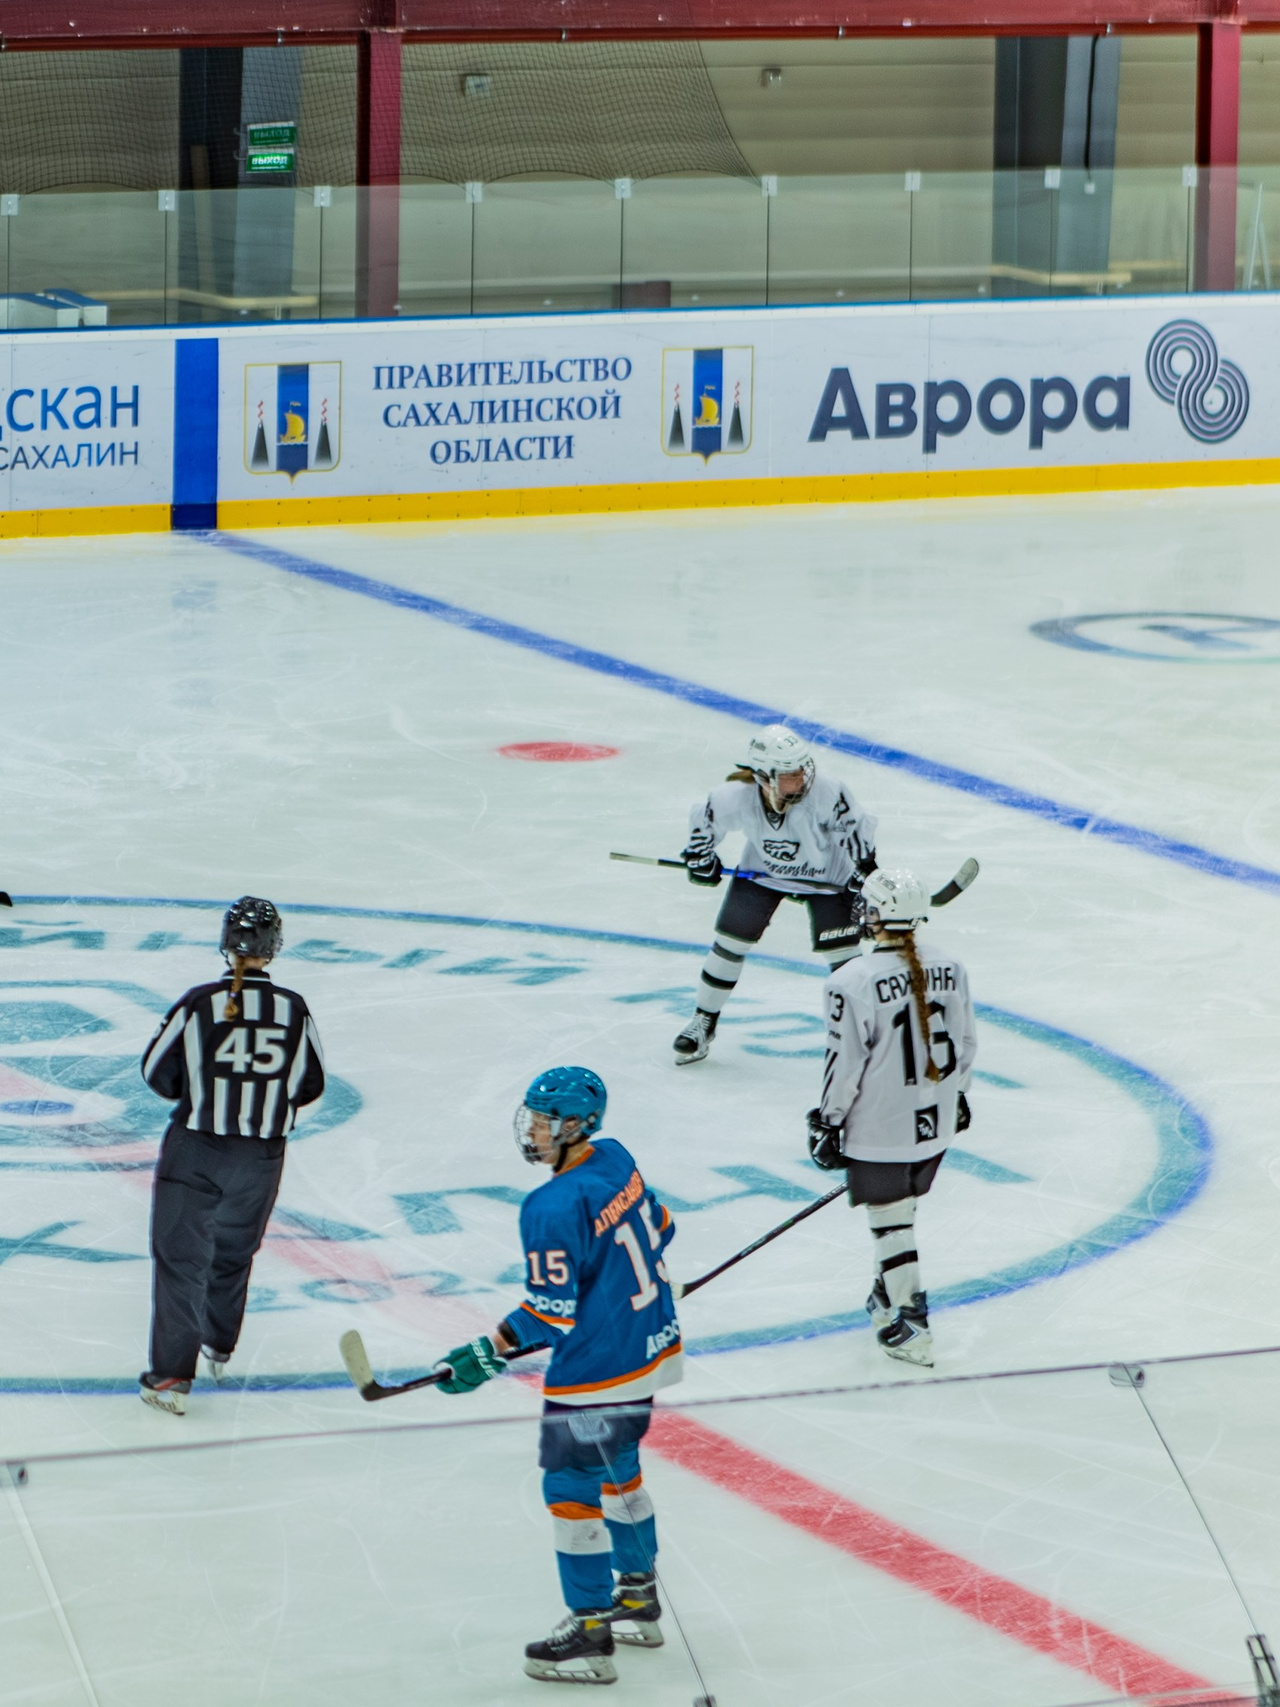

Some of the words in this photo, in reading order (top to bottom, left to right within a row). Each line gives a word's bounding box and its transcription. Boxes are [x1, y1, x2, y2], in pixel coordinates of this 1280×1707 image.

[372, 356, 632, 392] ПРАВИТЕЛЬСТВО
[381, 388, 622, 429] САХАЛИНСКОЙ
[807, 367, 1131, 454] Аврора
[428, 433, 575, 467] ОБЛАСТИ
[215, 1027, 287, 1074] 45
[527, 1249, 569, 1286] 15
